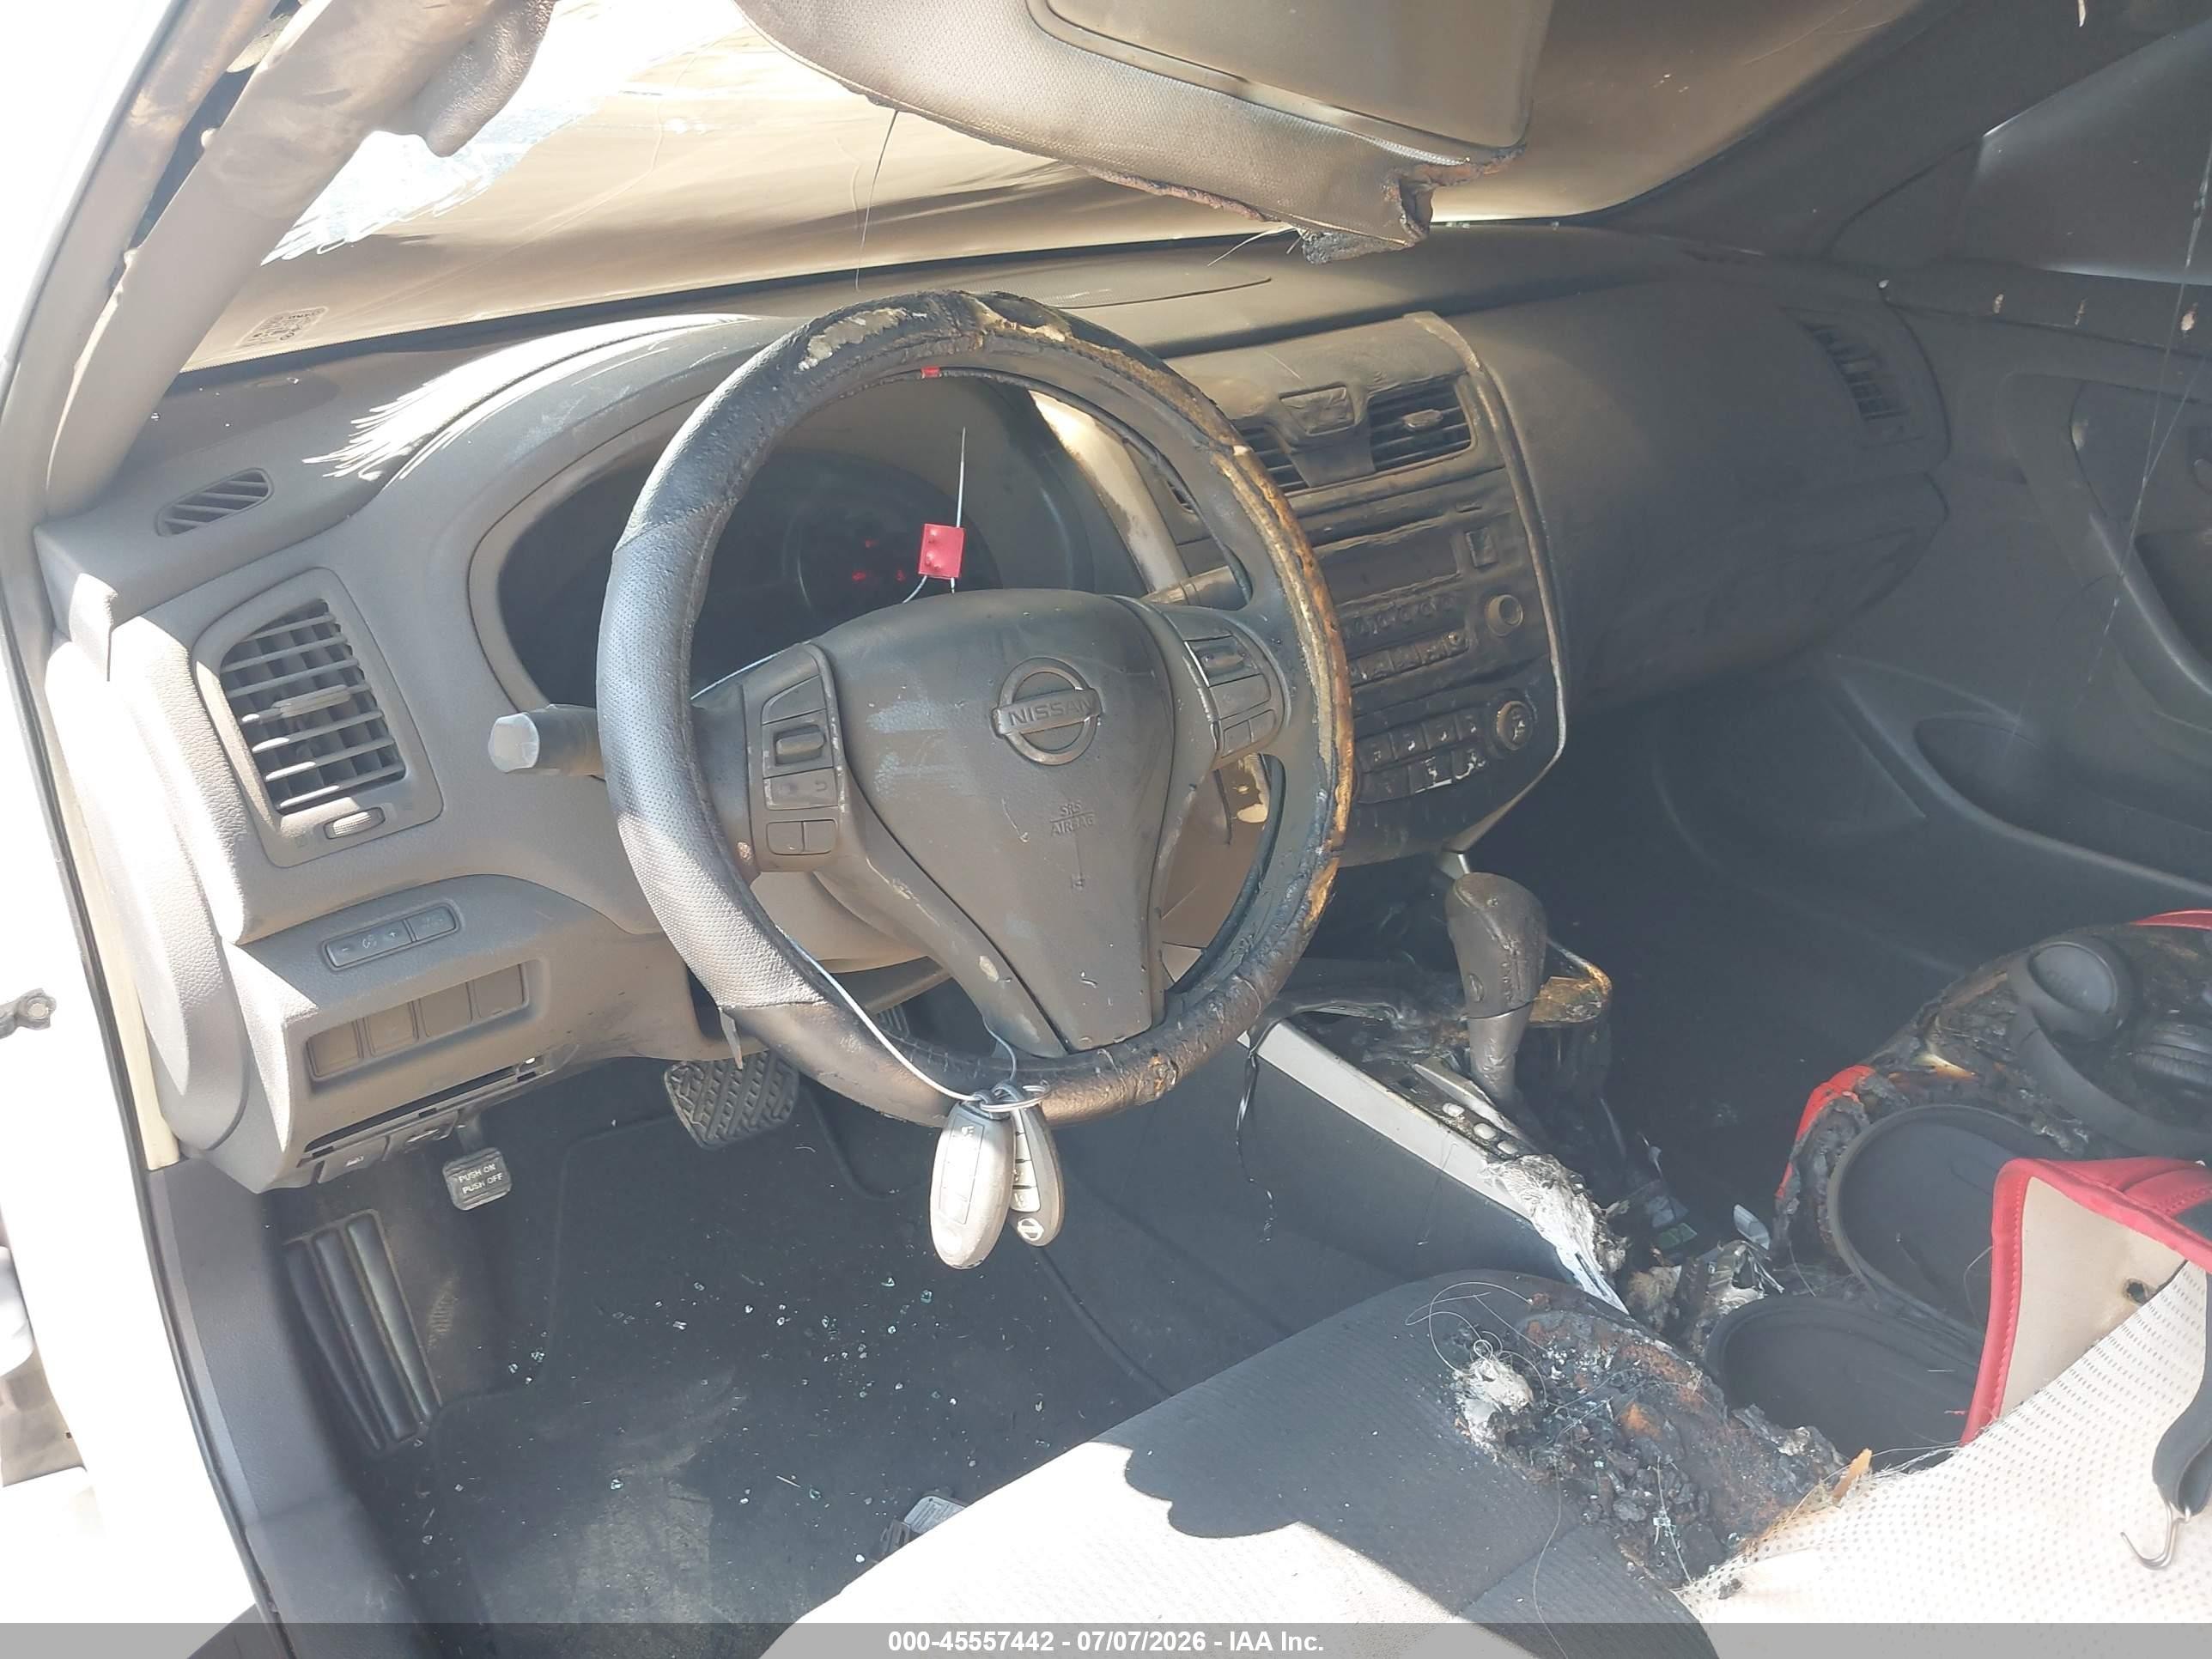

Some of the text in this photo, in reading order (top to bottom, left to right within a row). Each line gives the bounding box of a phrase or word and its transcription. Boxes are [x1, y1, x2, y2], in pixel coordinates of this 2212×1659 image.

[1008, 698, 1093, 726] NISSAN
[459, 1164, 496, 1183] PUSH ON
[462, 1173, 502, 1194] PUSH OFF
